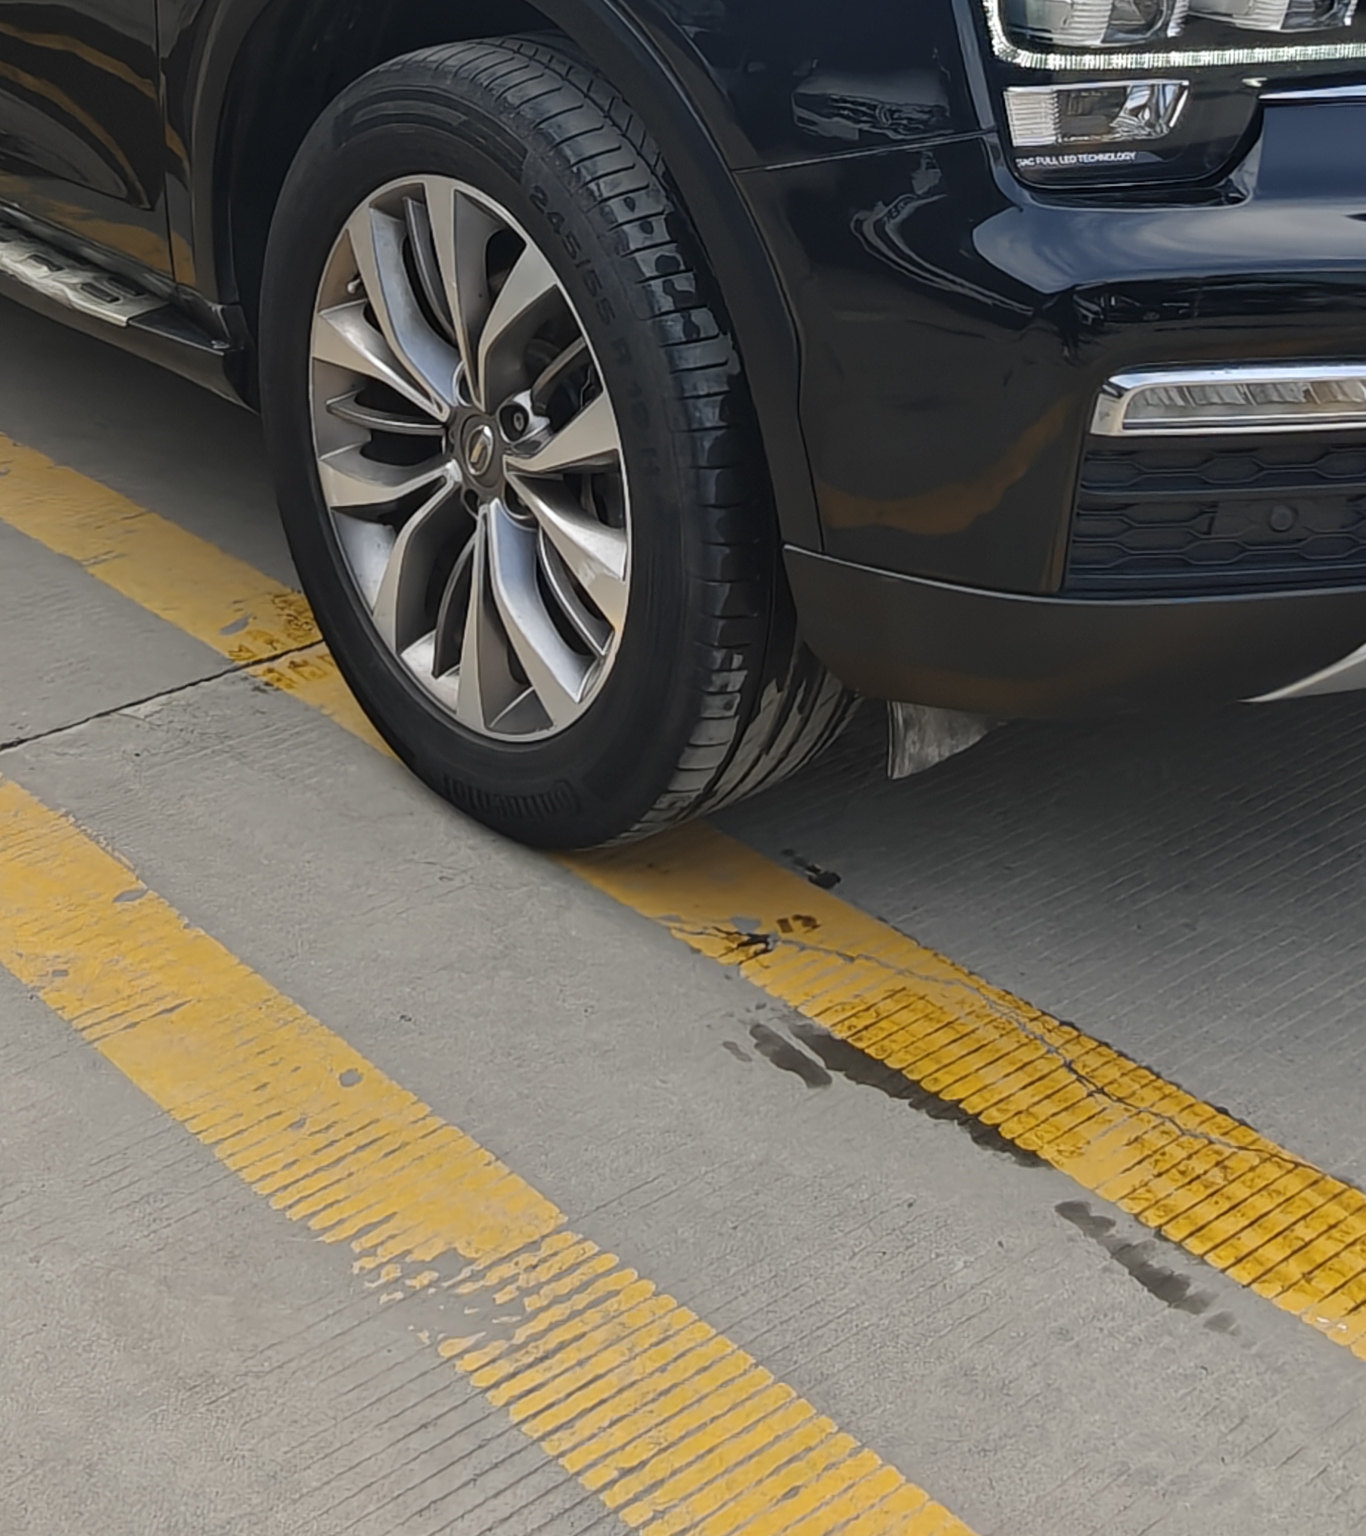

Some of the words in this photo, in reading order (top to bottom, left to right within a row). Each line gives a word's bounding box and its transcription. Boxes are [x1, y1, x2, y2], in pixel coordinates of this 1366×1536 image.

[1035, 155, 1058, 166] FULL
[1058, 154, 1077, 165] LED
[1077, 151, 1136, 164] TECHNOLOGY
